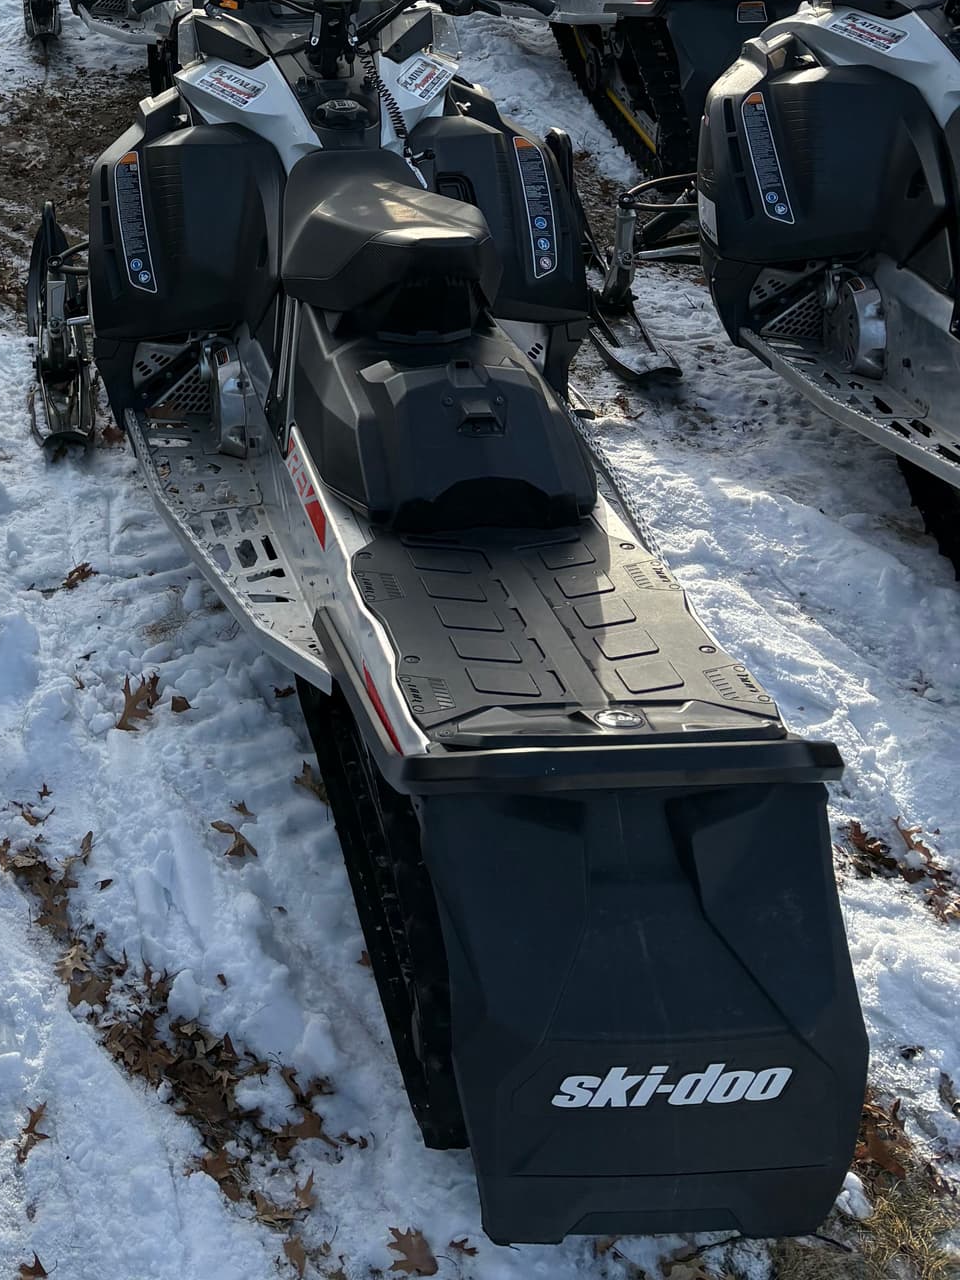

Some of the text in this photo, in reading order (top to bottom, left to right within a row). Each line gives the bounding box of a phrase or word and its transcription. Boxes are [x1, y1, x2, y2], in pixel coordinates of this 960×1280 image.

[844, 15, 902, 40] PLATINUM
[214, 68, 261, 94] PLATINUM
[551, 1063, 793, 1108] ski-doo
